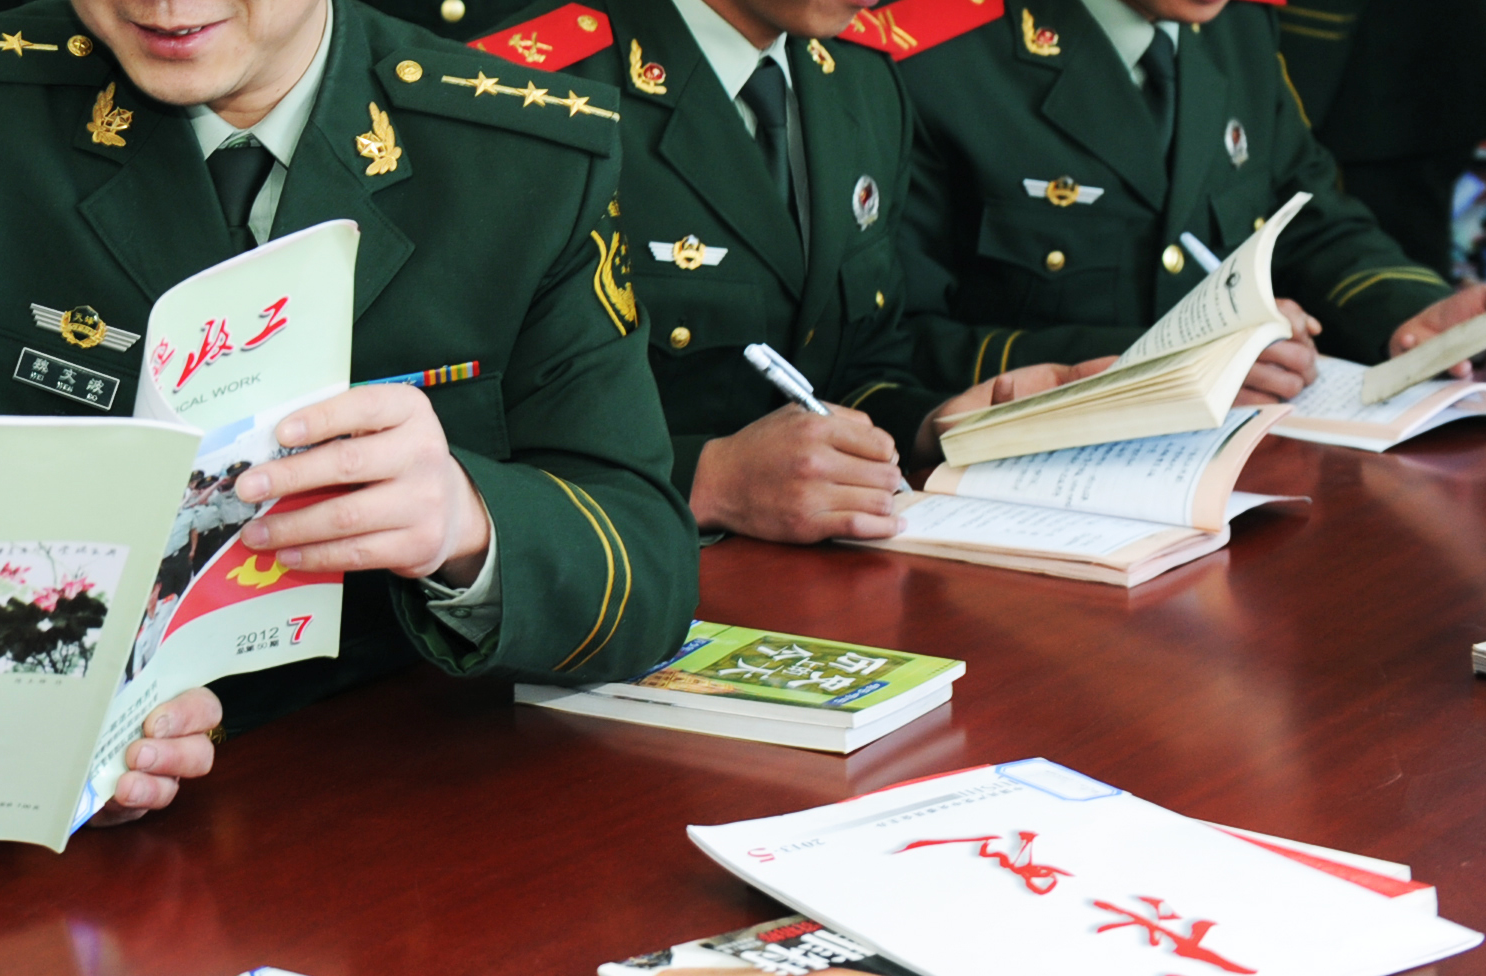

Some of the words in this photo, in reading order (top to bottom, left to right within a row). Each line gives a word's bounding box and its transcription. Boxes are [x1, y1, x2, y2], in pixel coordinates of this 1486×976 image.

[212, 372, 262, 399] WORK
[236, 626, 280, 648] 2012
[287, 614, 314, 645] 7
